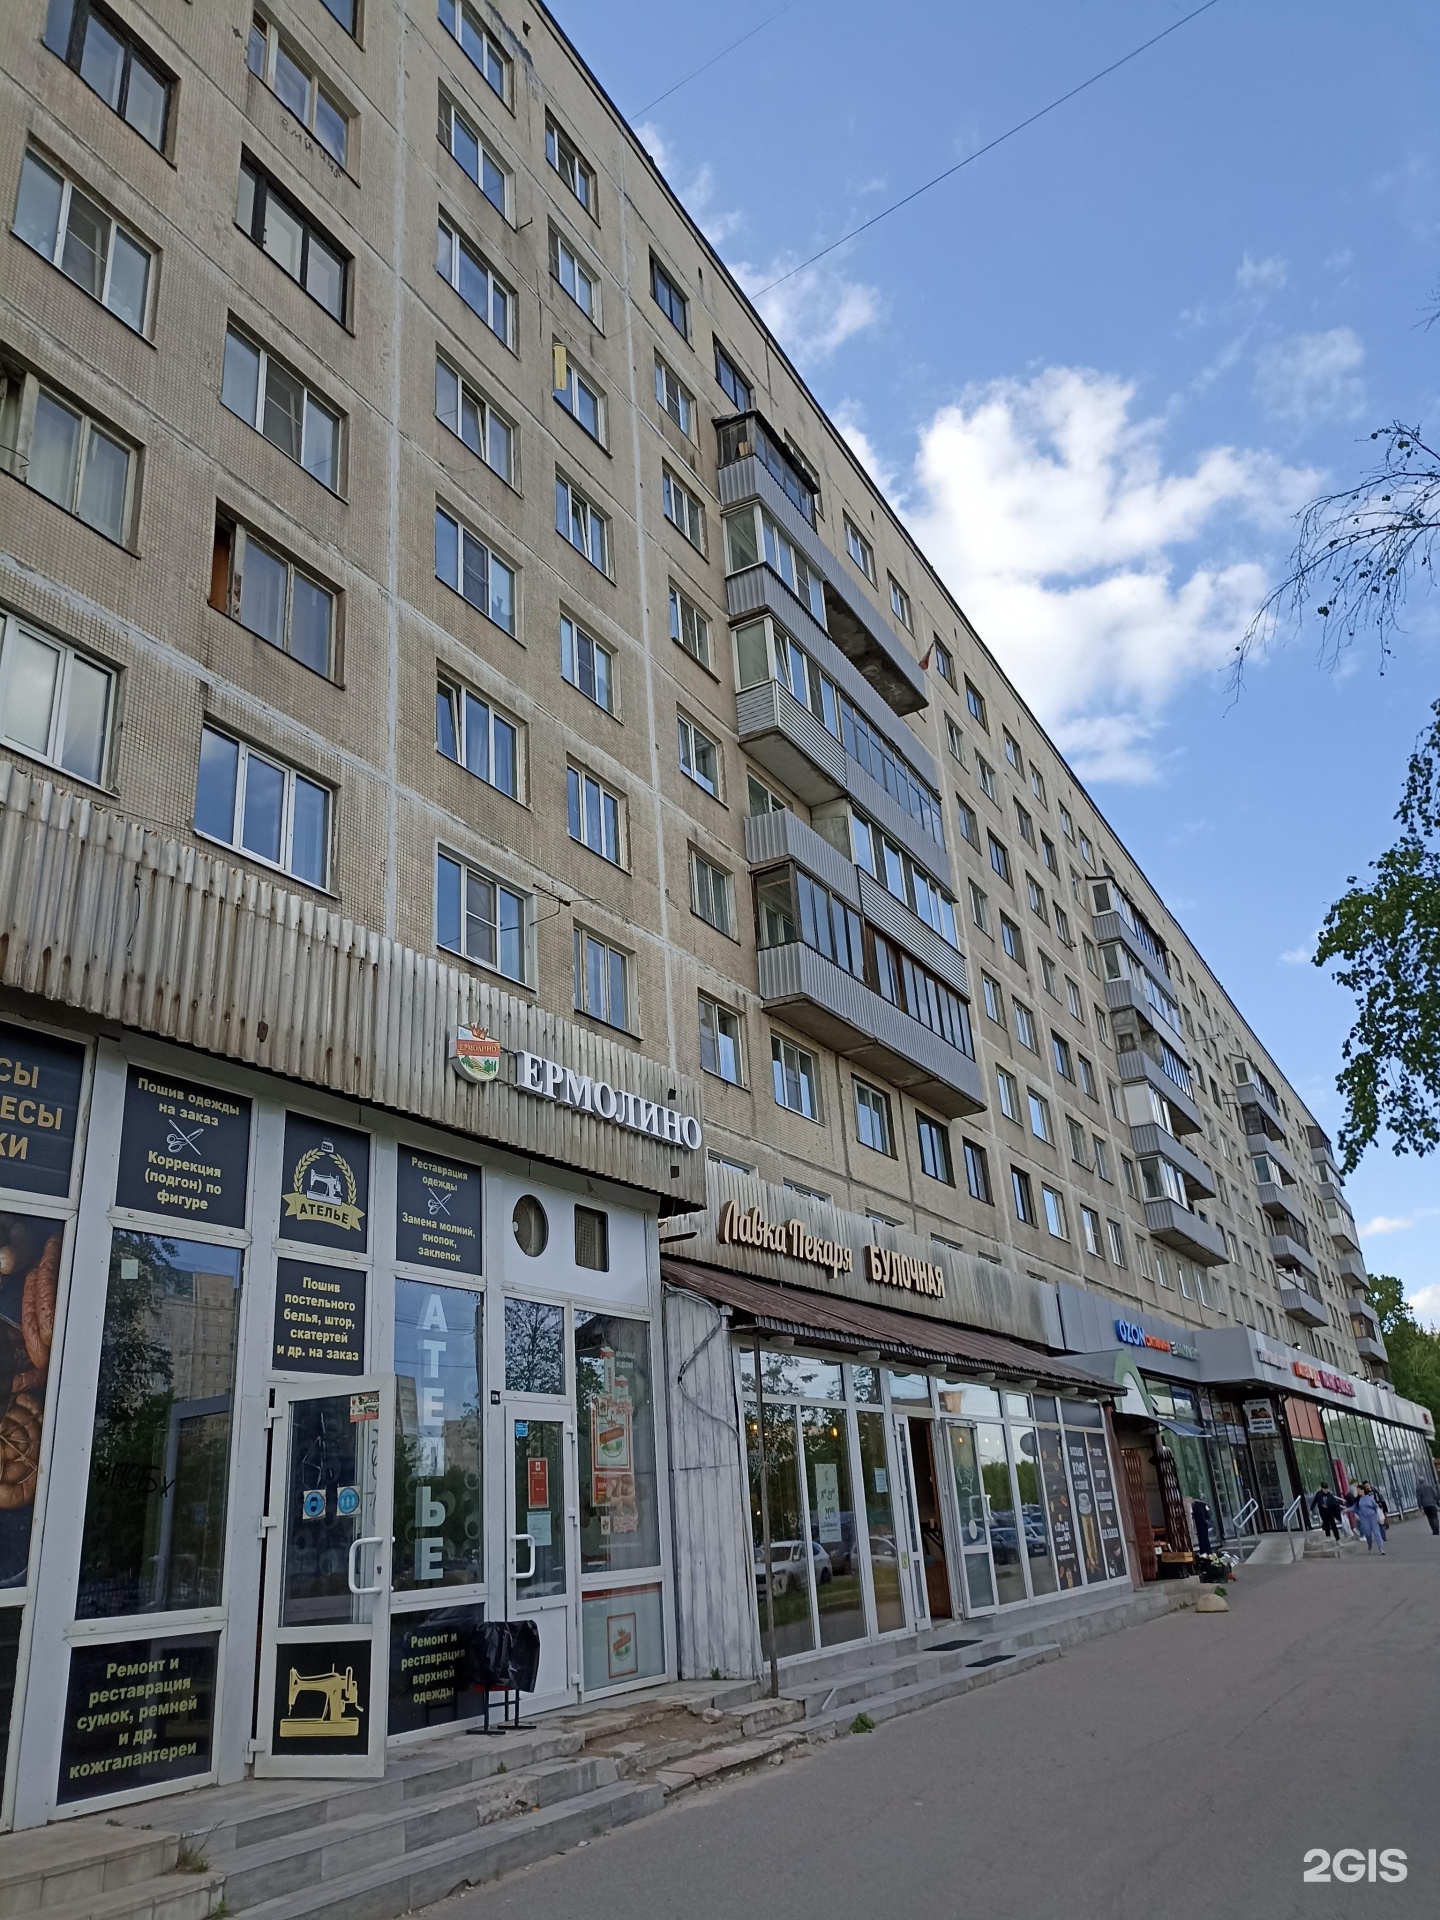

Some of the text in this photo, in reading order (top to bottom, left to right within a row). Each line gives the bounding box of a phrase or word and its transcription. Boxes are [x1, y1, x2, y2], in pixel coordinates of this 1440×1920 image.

[460, 1043, 497, 1053] ЕРМОЛИНО
[138, 1077, 239, 1115] Пошив одежды
[516, 1050, 702, 1149] ЕРМОЛИНО
[158, 1103, 219, 1126] на заказ
[148, 1150, 221, 1177] Коррекция
[411, 1157, 468, 1180] Реставрация
[144, 1168, 222, 1195] (подгон) по
[422, 1176, 458, 1191] одежды
[157, 1189, 208, 1210] фигуре
[299, 1203, 349, 1225] АТЕЛЬЕ
[402, 1211, 476, 1238] Замена молний,
[422, 1233, 457, 1248] кнопок,
[720, 1200, 946, 1298] Лавка Пекаря БУЛОЧНАЯ
[418, 1246, 461, 1262] заклепок
[302, 1276, 341, 1293] Пошив
[284, 1293, 356, 1311] постельного
[283, 1308, 355, 1329] белья, штор,
[290, 1328, 348, 1344] скатертей
[1116, 1319, 1146, 1347] OZON
[276, 1344, 359, 1361] и др. на заказ
[415, 1293, 448, 1581] АТЕЛЬЕ
[410, 1633, 458, 1648] Ремонт и
[106, 1658, 179, 1679] Ремонт и
[401, 1649, 466, 1671] реставрация
[412, 1666, 455, 1685] верхней
[88, 1677, 191, 1708] реставрация
[413, 1687, 454, 1704] одежды
[76, 1695, 198, 1732] сумок, ремней
[118, 1728, 157, 1746] и др.
[69, 1742, 197, 1779] кожгалантереи
